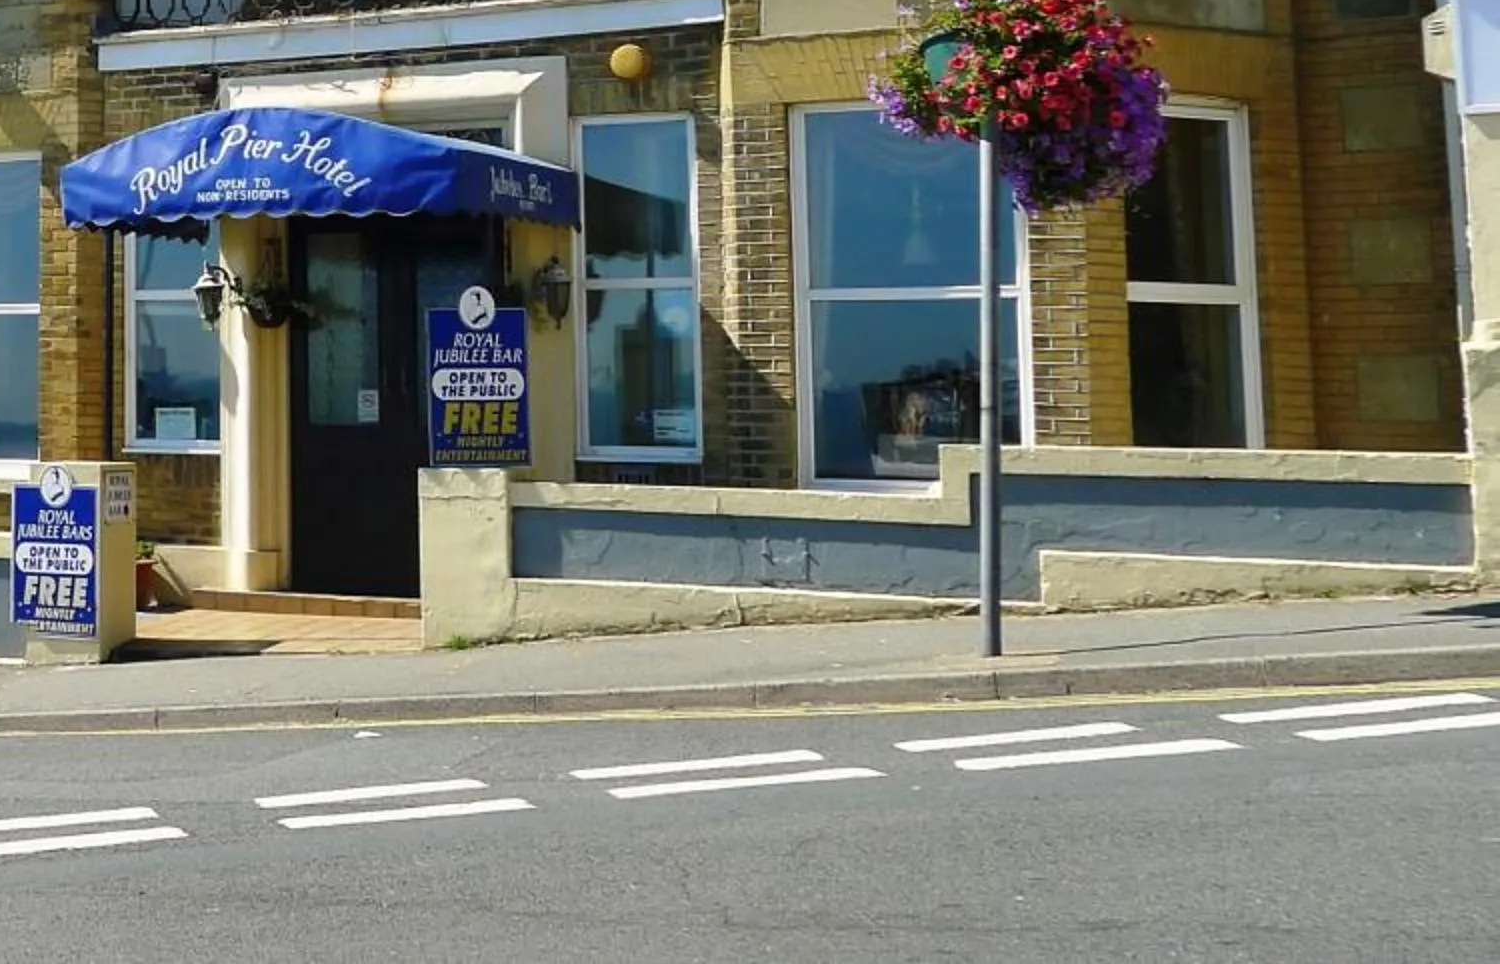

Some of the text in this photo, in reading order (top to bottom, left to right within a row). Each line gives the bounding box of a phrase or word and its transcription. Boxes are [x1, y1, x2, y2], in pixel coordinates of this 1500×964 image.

[130, 123, 372, 215] Royal Pier Hotel
[215, 177, 271, 191] OPEN TO
[196, 189, 290, 204] NON-RESIDENTS
[453, 332, 503, 348] ROYAL
[433, 348, 523, 367] JUBILEE BAR
[449, 371, 507, 384] OPEN TO
[441, 384, 517, 397] THE PUBLIC
[443, 401, 520, 435] FREE
[457, 436, 506, 448] NIGHTLY
[435, 449, 527, 461] ENTERTAINMENT
[38, 509, 76, 525] ROYAL
[17, 524, 93, 541] JUBILEE BARS
[29, 546, 79, 558] OPEN TO
[22, 559, 87, 571] THE PUBLIC
[23, 575, 89, 608] FREE
